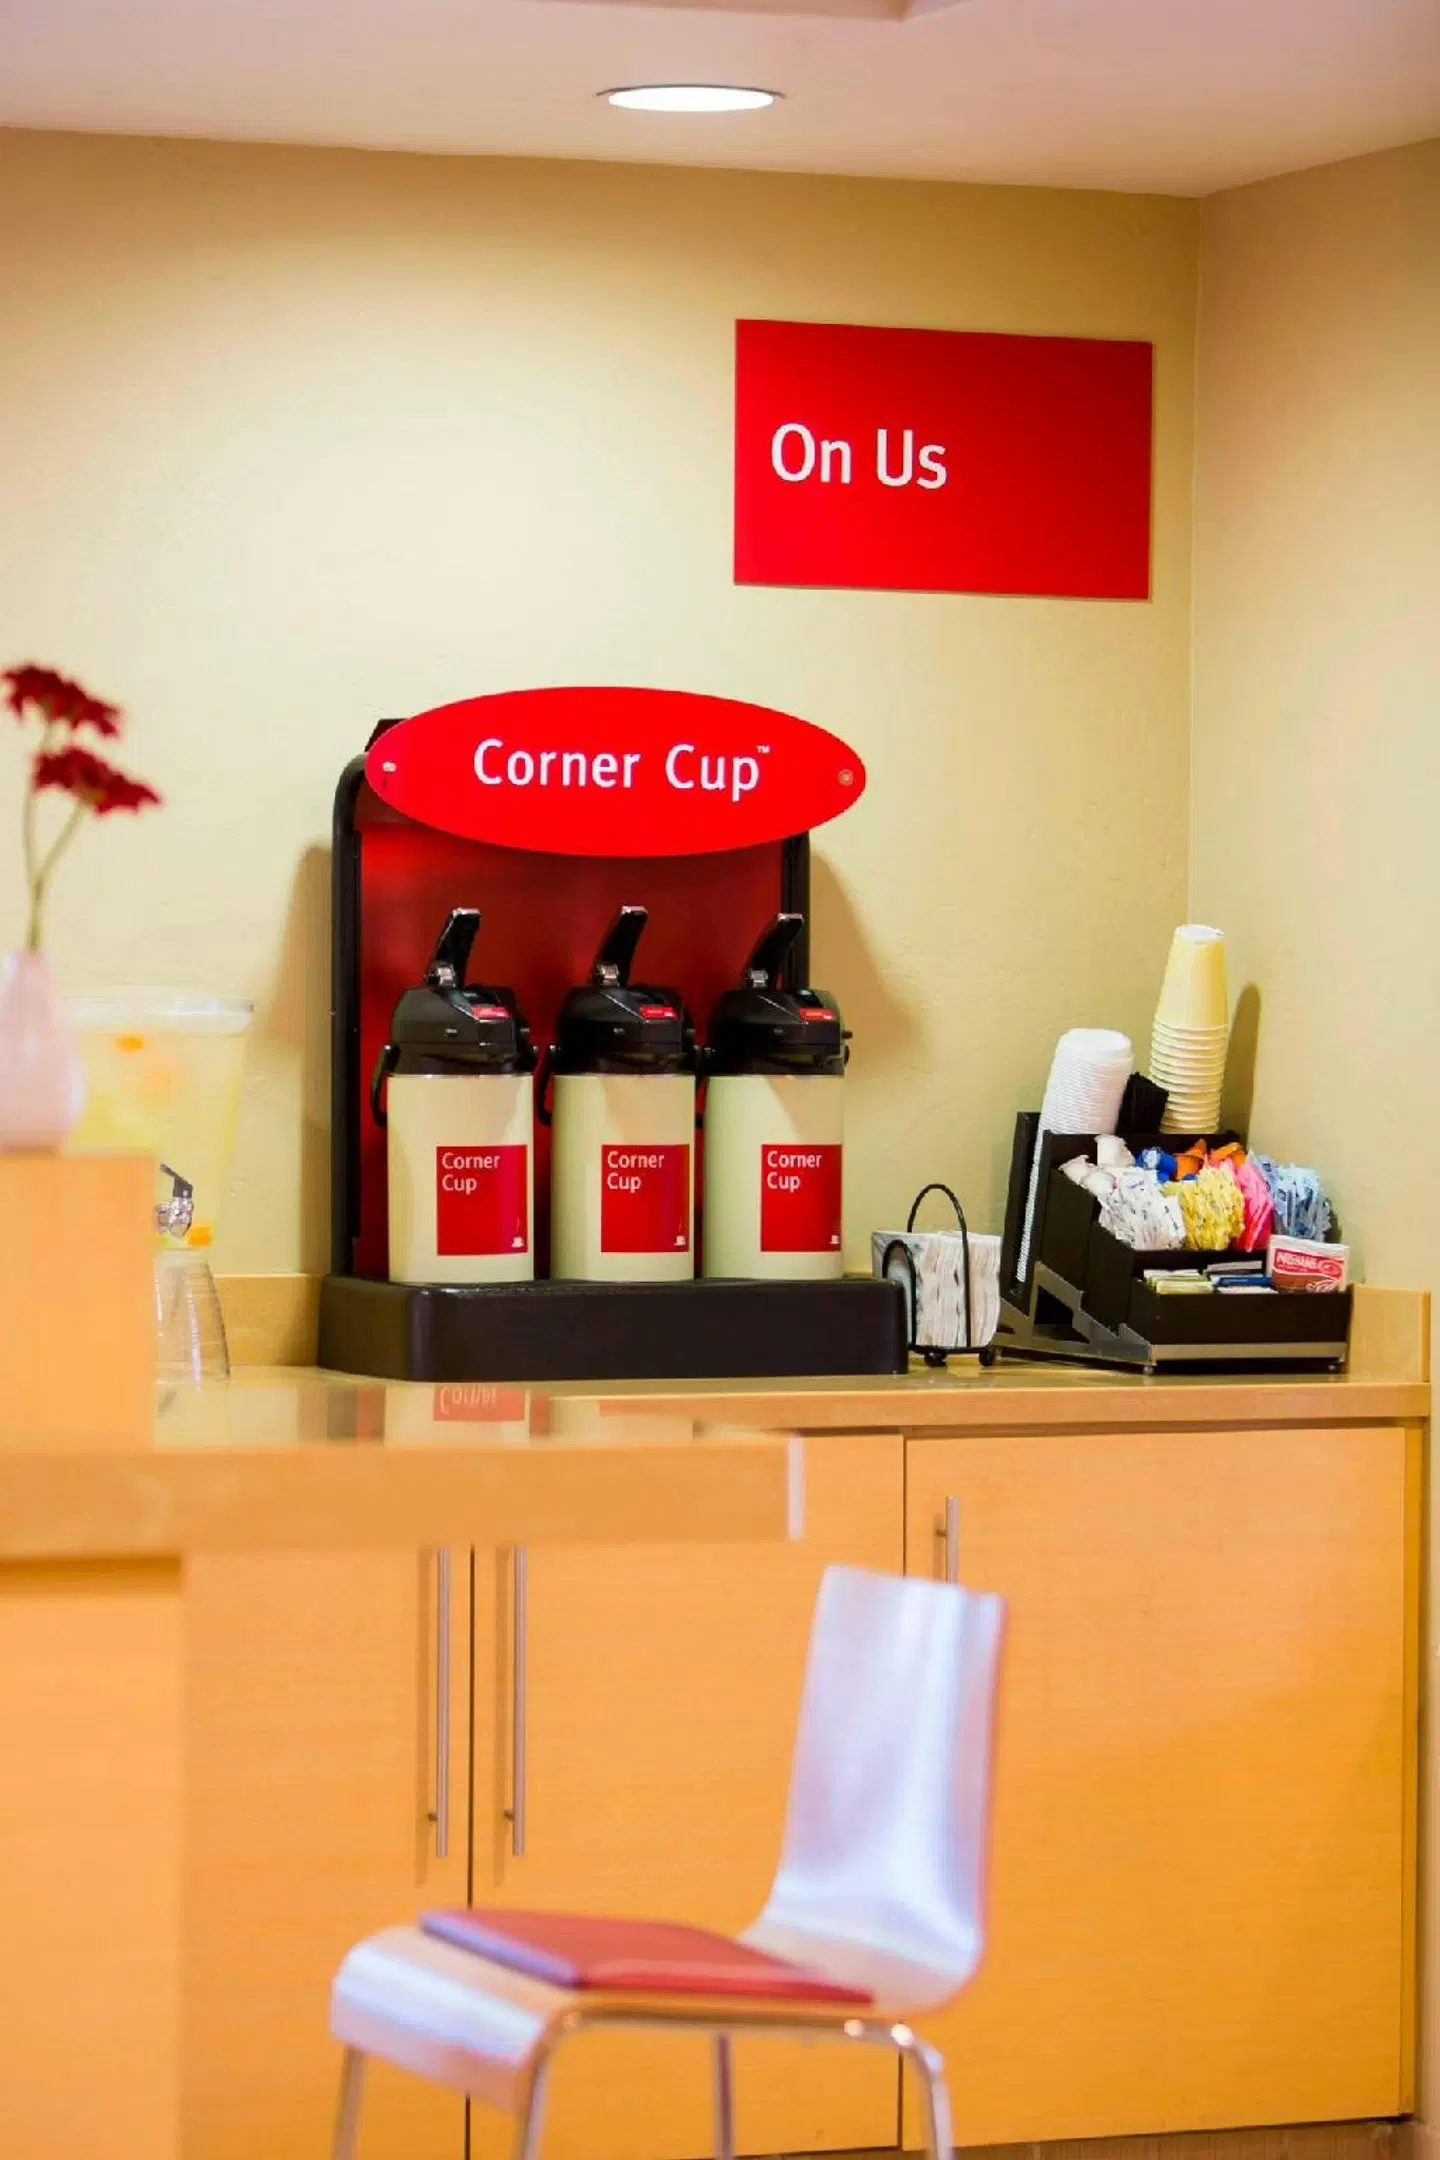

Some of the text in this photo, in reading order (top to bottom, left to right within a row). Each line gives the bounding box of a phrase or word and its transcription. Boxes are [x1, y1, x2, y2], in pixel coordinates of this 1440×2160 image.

[771, 423, 947, 489] On Us
[473, 738, 641, 788] Corner
[442, 1152, 500, 1170] Corner
[607, 1150, 665, 1169] Corner
[767, 1150, 822, 1168] Corner
[442, 1174, 477, 1195] Cup
[607, 1171, 642, 1194] Cup
[767, 1171, 801, 1193] Cup
